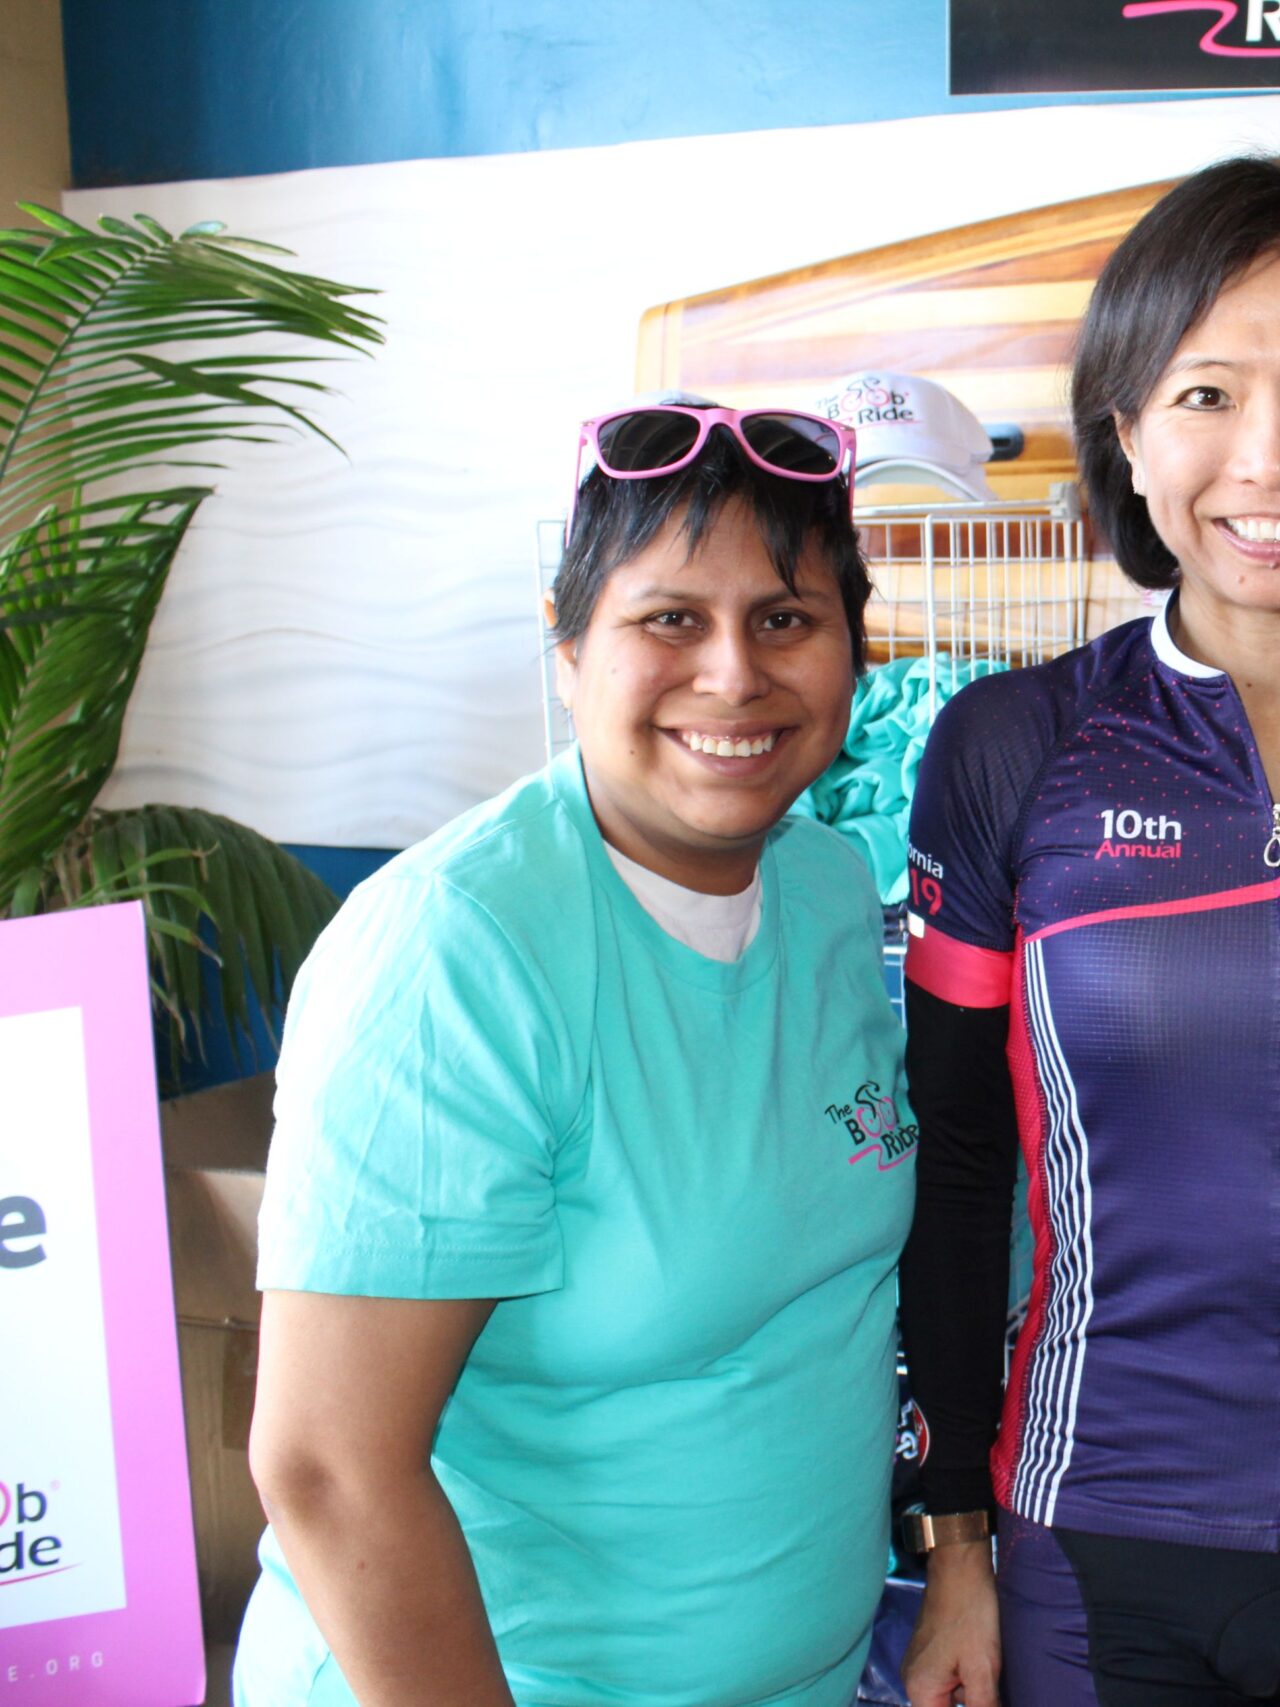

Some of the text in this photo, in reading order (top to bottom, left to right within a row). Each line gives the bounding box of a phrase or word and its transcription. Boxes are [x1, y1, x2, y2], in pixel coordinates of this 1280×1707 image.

[858, 407, 914, 424] Ride
[1100, 809, 1182, 840] 10th
[1095, 840, 1182, 860] Annual
[824, 1104, 853, 1124] The
